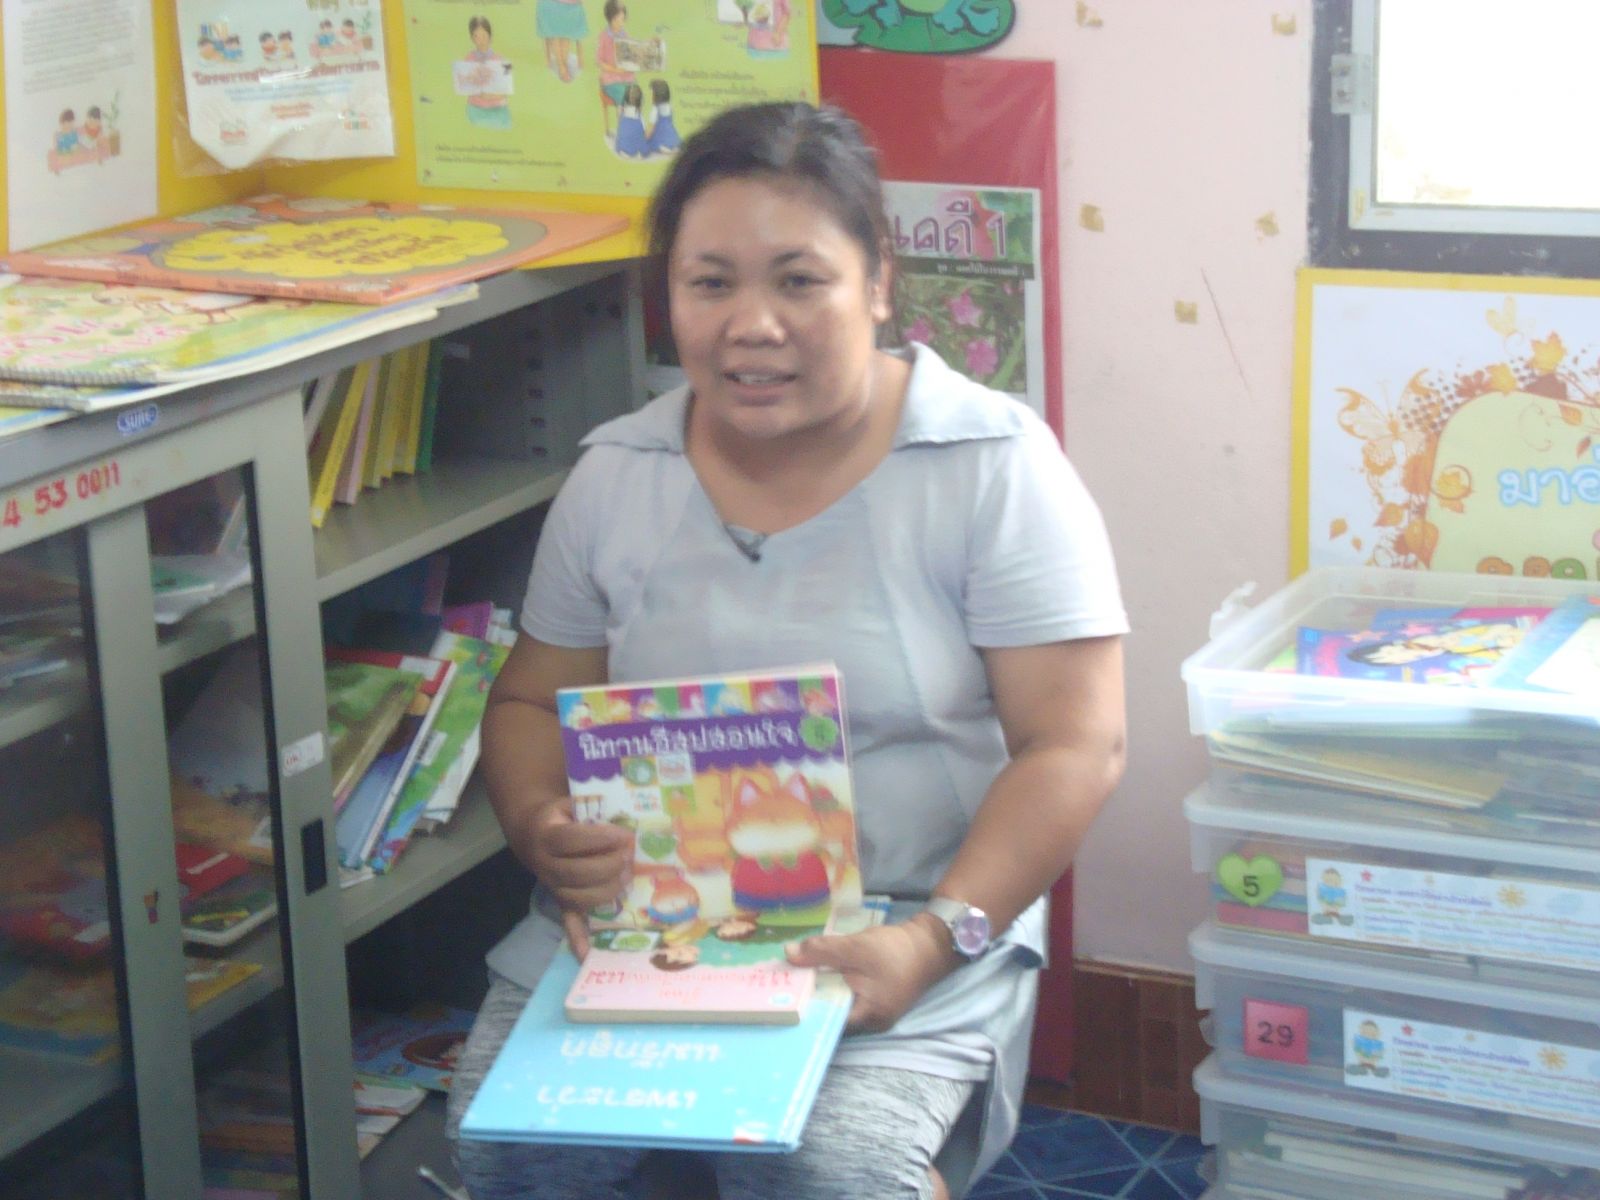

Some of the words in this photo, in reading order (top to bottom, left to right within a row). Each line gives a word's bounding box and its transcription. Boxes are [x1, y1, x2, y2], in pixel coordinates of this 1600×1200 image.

[35, 479, 67, 515] 53
[77, 461, 119, 499] 0011
[578, 719, 796, 761] 5
[1256, 1020, 1295, 1048] 29
